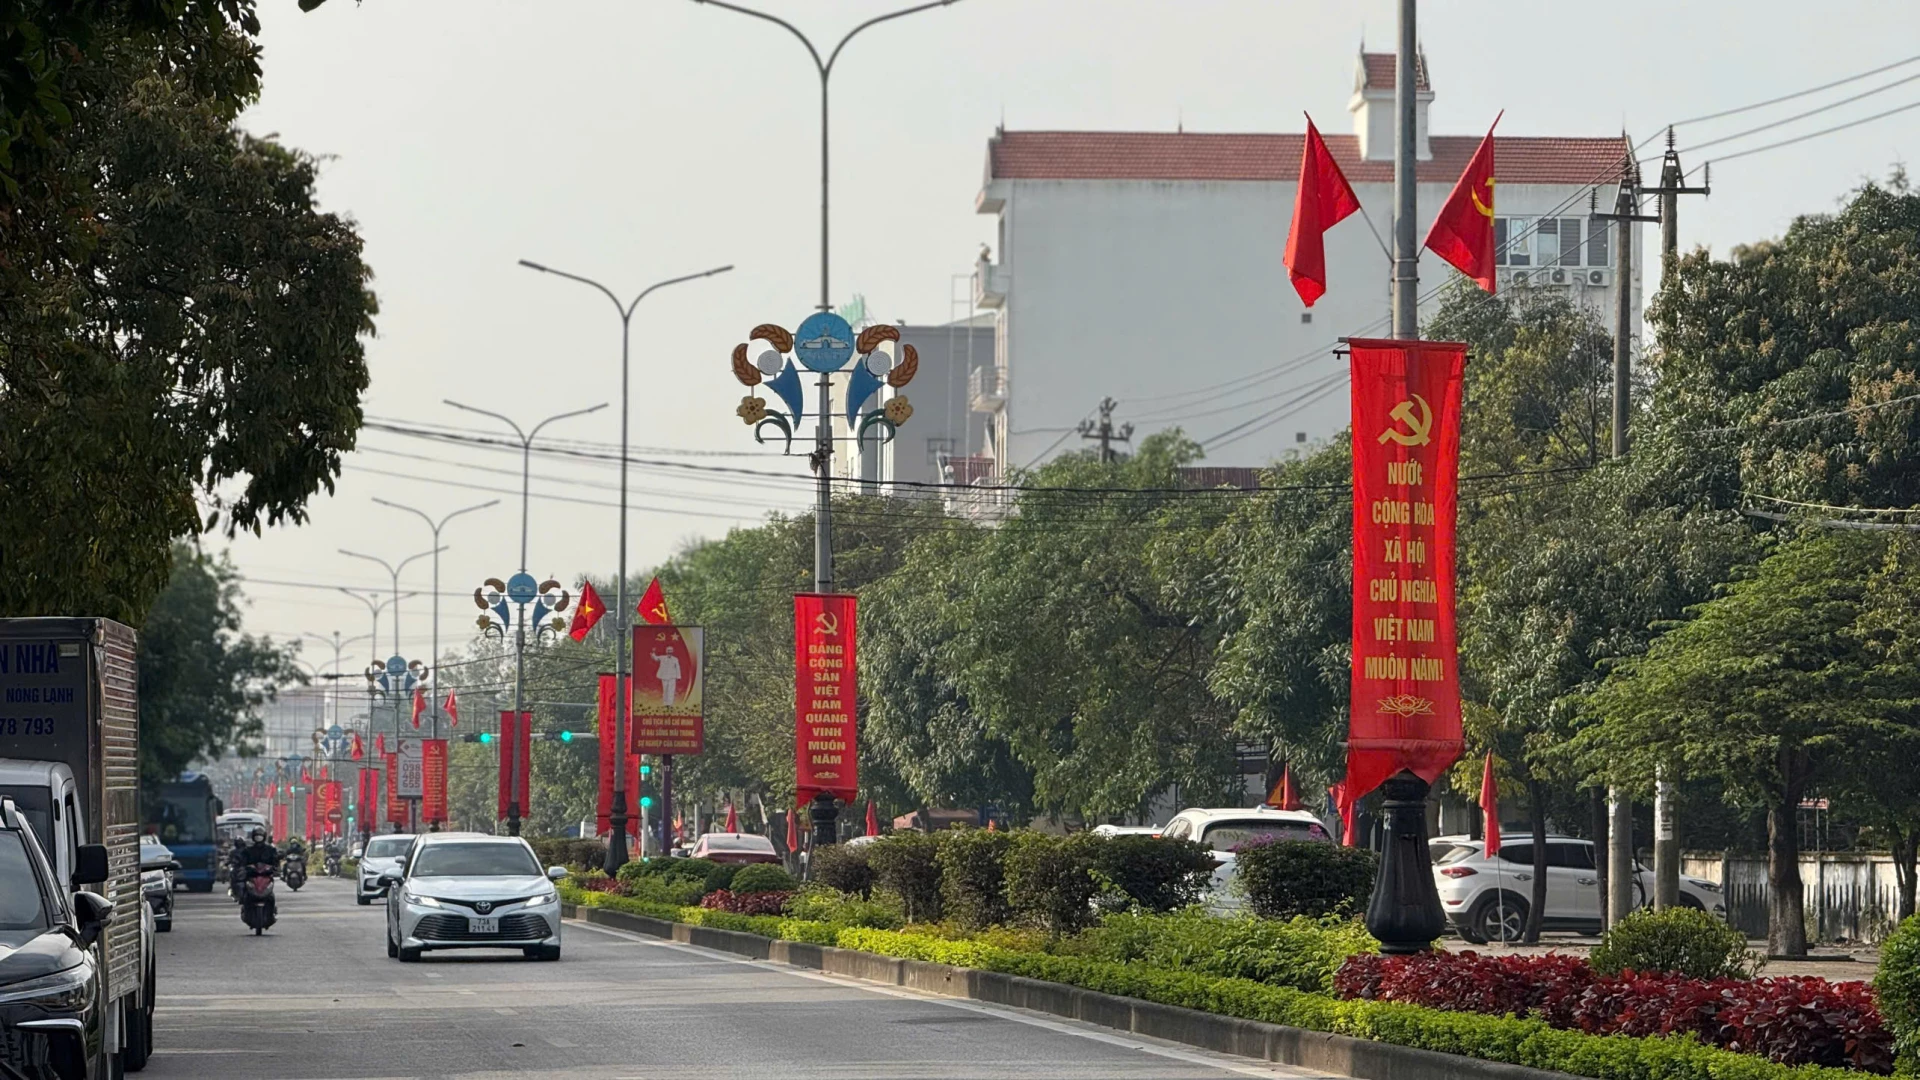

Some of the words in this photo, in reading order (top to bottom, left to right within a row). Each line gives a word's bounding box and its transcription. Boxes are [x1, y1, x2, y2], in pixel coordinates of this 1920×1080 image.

[1388, 458, 1422, 485] NƯỚC
[1372, 496, 1410, 528] CỘNG
[1414, 497, 1435, 525] HÒA
[1384, 536, 1402, 562] XÃ
[1406, 536, 1425, 568] HỘI
[1370, 571, 1397, 602] CHỦ
[1401, 576, 1437, 603] NGHĨA
[1374, 613, 1403, 646] VIỆT
[1407, 619, 1435, 642] NAM
[808, 642, 843, 655] ĐẢNG
[16, 640, 59, 674] NHÀ
[809, 658, 843, 669] CỘNG
[1365, 652, 1407, 680] MUÔN
[1411, 654, 1444, 681] NĂM!
[814, 668, 840, 682] SẢN
[43, 687, 74, 705] LẠNH
[814, 685, 840, 697] VIỆT
[812, 700, 841, 710] NAM
[805, 713, 848, 724] QUANG
[22, 718, 54, 735] 793
[812, 727, 842, 737] VINH
[808, 740, 846, 751] MUÔN
[812, 753, 842, 764] NĂM
[402, 763, 421, 771] 098
